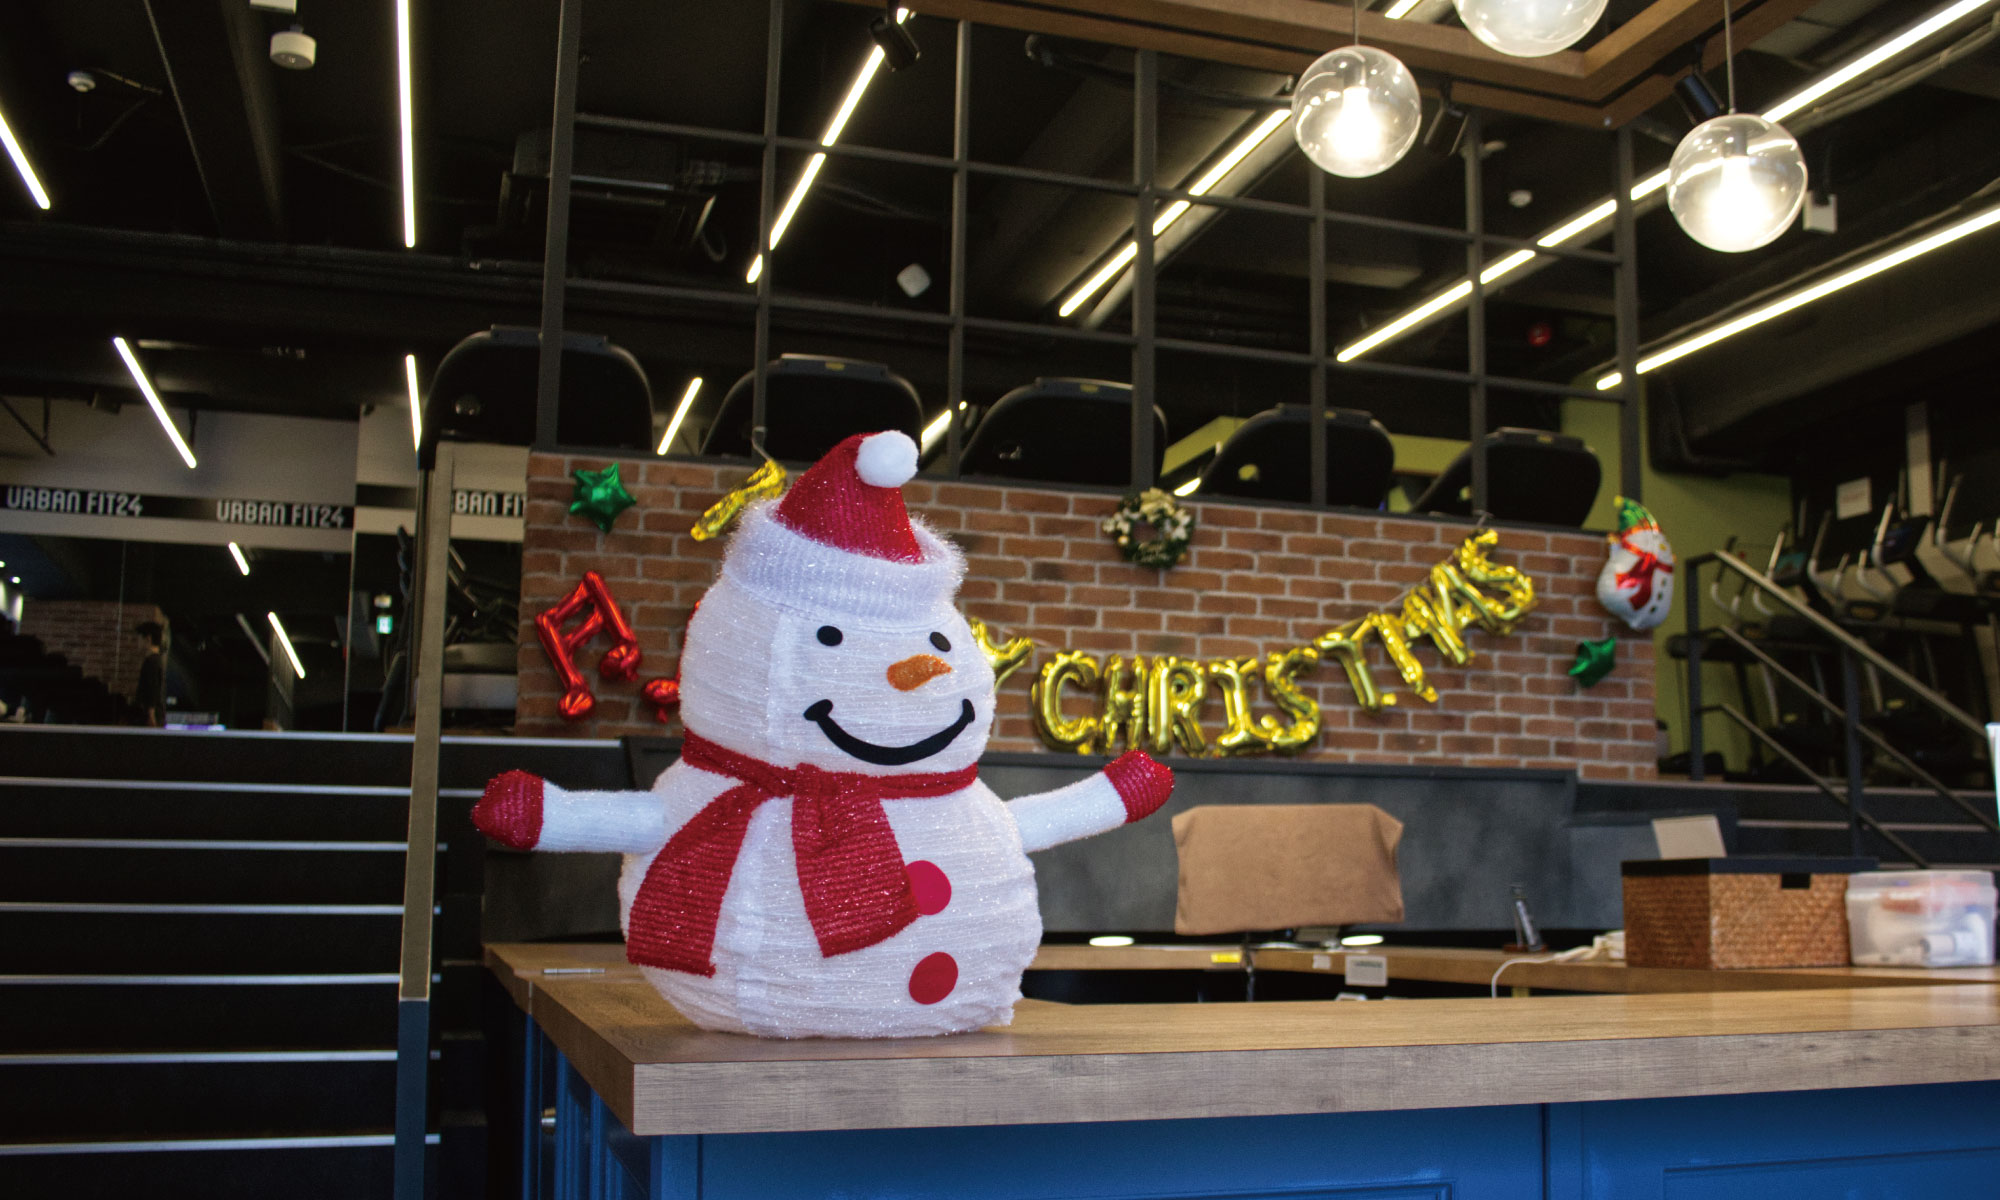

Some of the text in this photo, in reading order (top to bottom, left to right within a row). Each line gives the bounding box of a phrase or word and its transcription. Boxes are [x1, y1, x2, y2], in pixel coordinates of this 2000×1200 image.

[7, 486, 143, 517] URBAN FIT24
[216, 500, 344, 529] URBAN FIT24
[452, 491, 497, 514] BAN
[1031, 528, 1536, 757] CHRISTMAS
